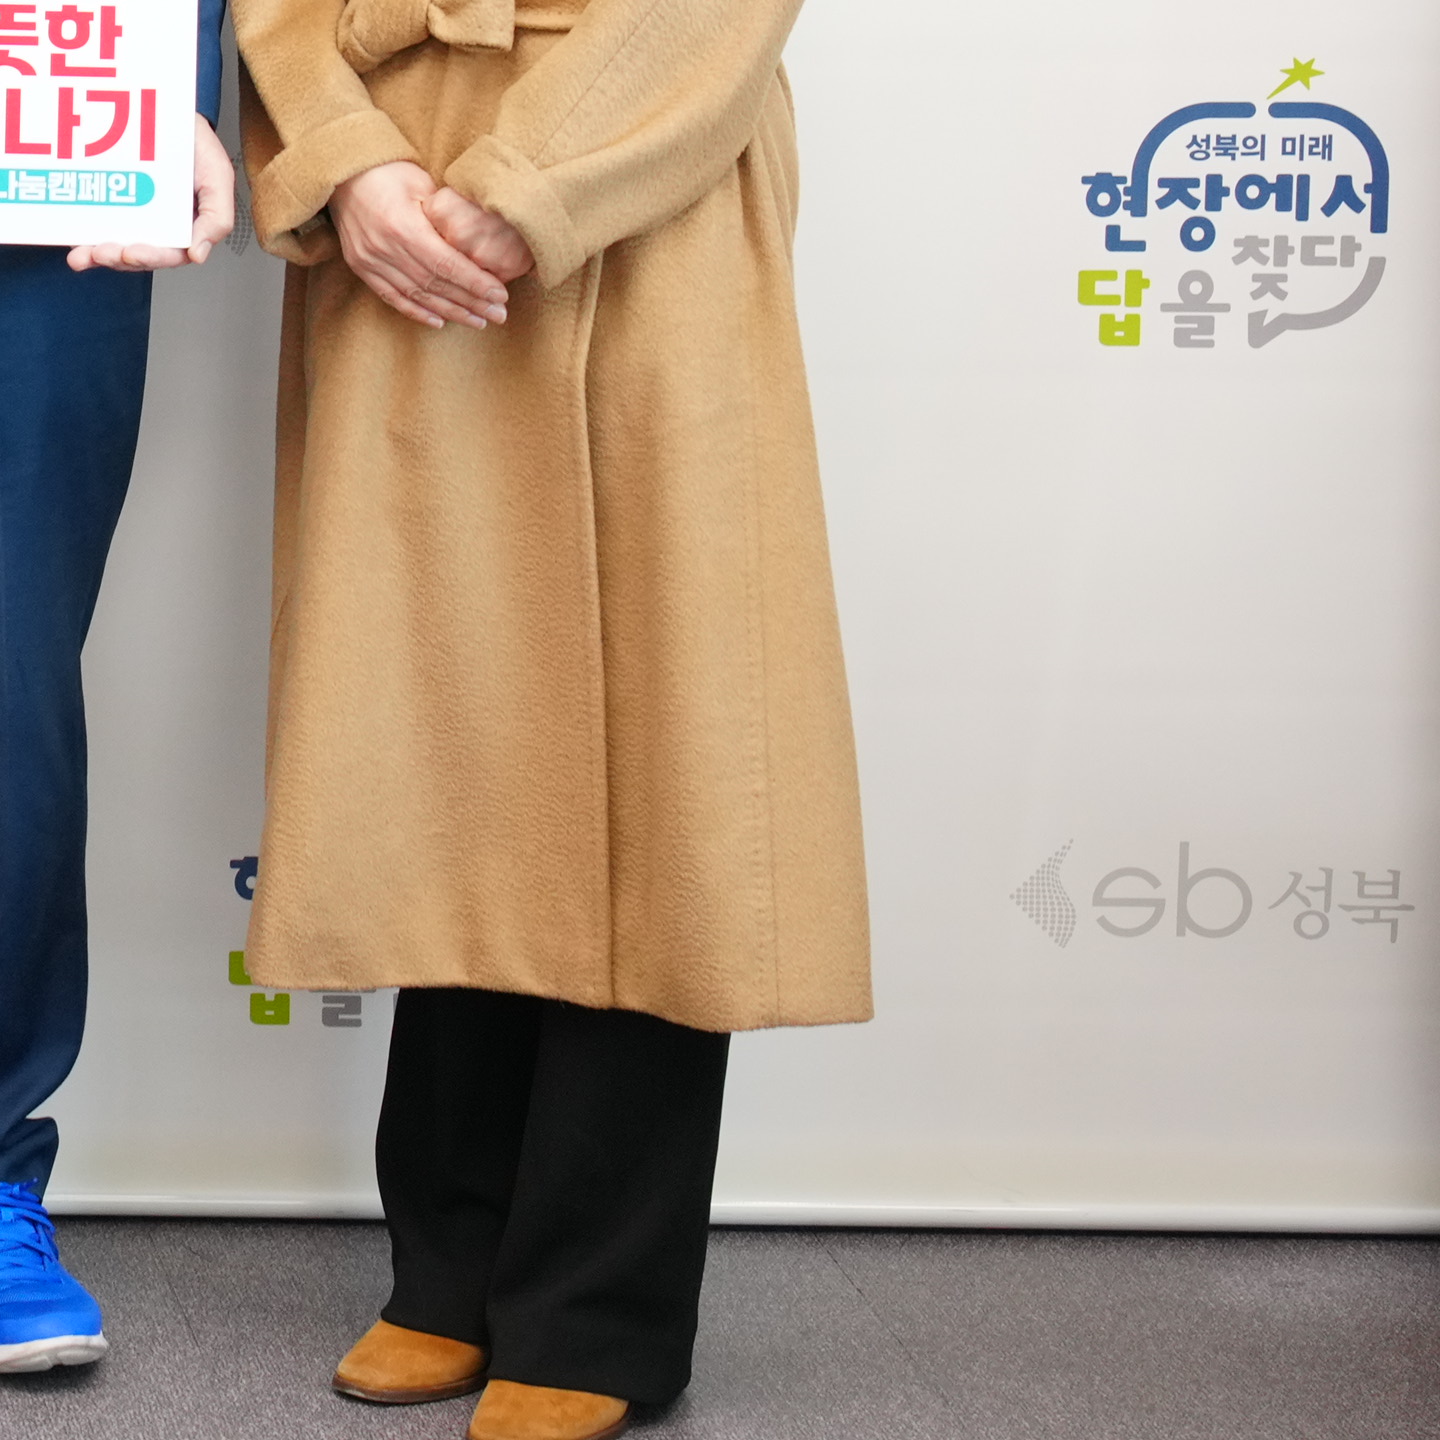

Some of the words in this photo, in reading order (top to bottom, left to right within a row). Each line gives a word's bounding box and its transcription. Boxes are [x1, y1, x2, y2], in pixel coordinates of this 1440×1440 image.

[1186, 134, 1266, 161] 성북의
[1281, 134, 1333, 161] 미래
[1081, 172, 1389, 252] 현장에서
[1077, 269, 1231, 348] 답을
[1231, 235, 1362, 301] 찾다
[1092, 841, 1253, 939] sb
[1267, 867, 1415, 944] 성북
